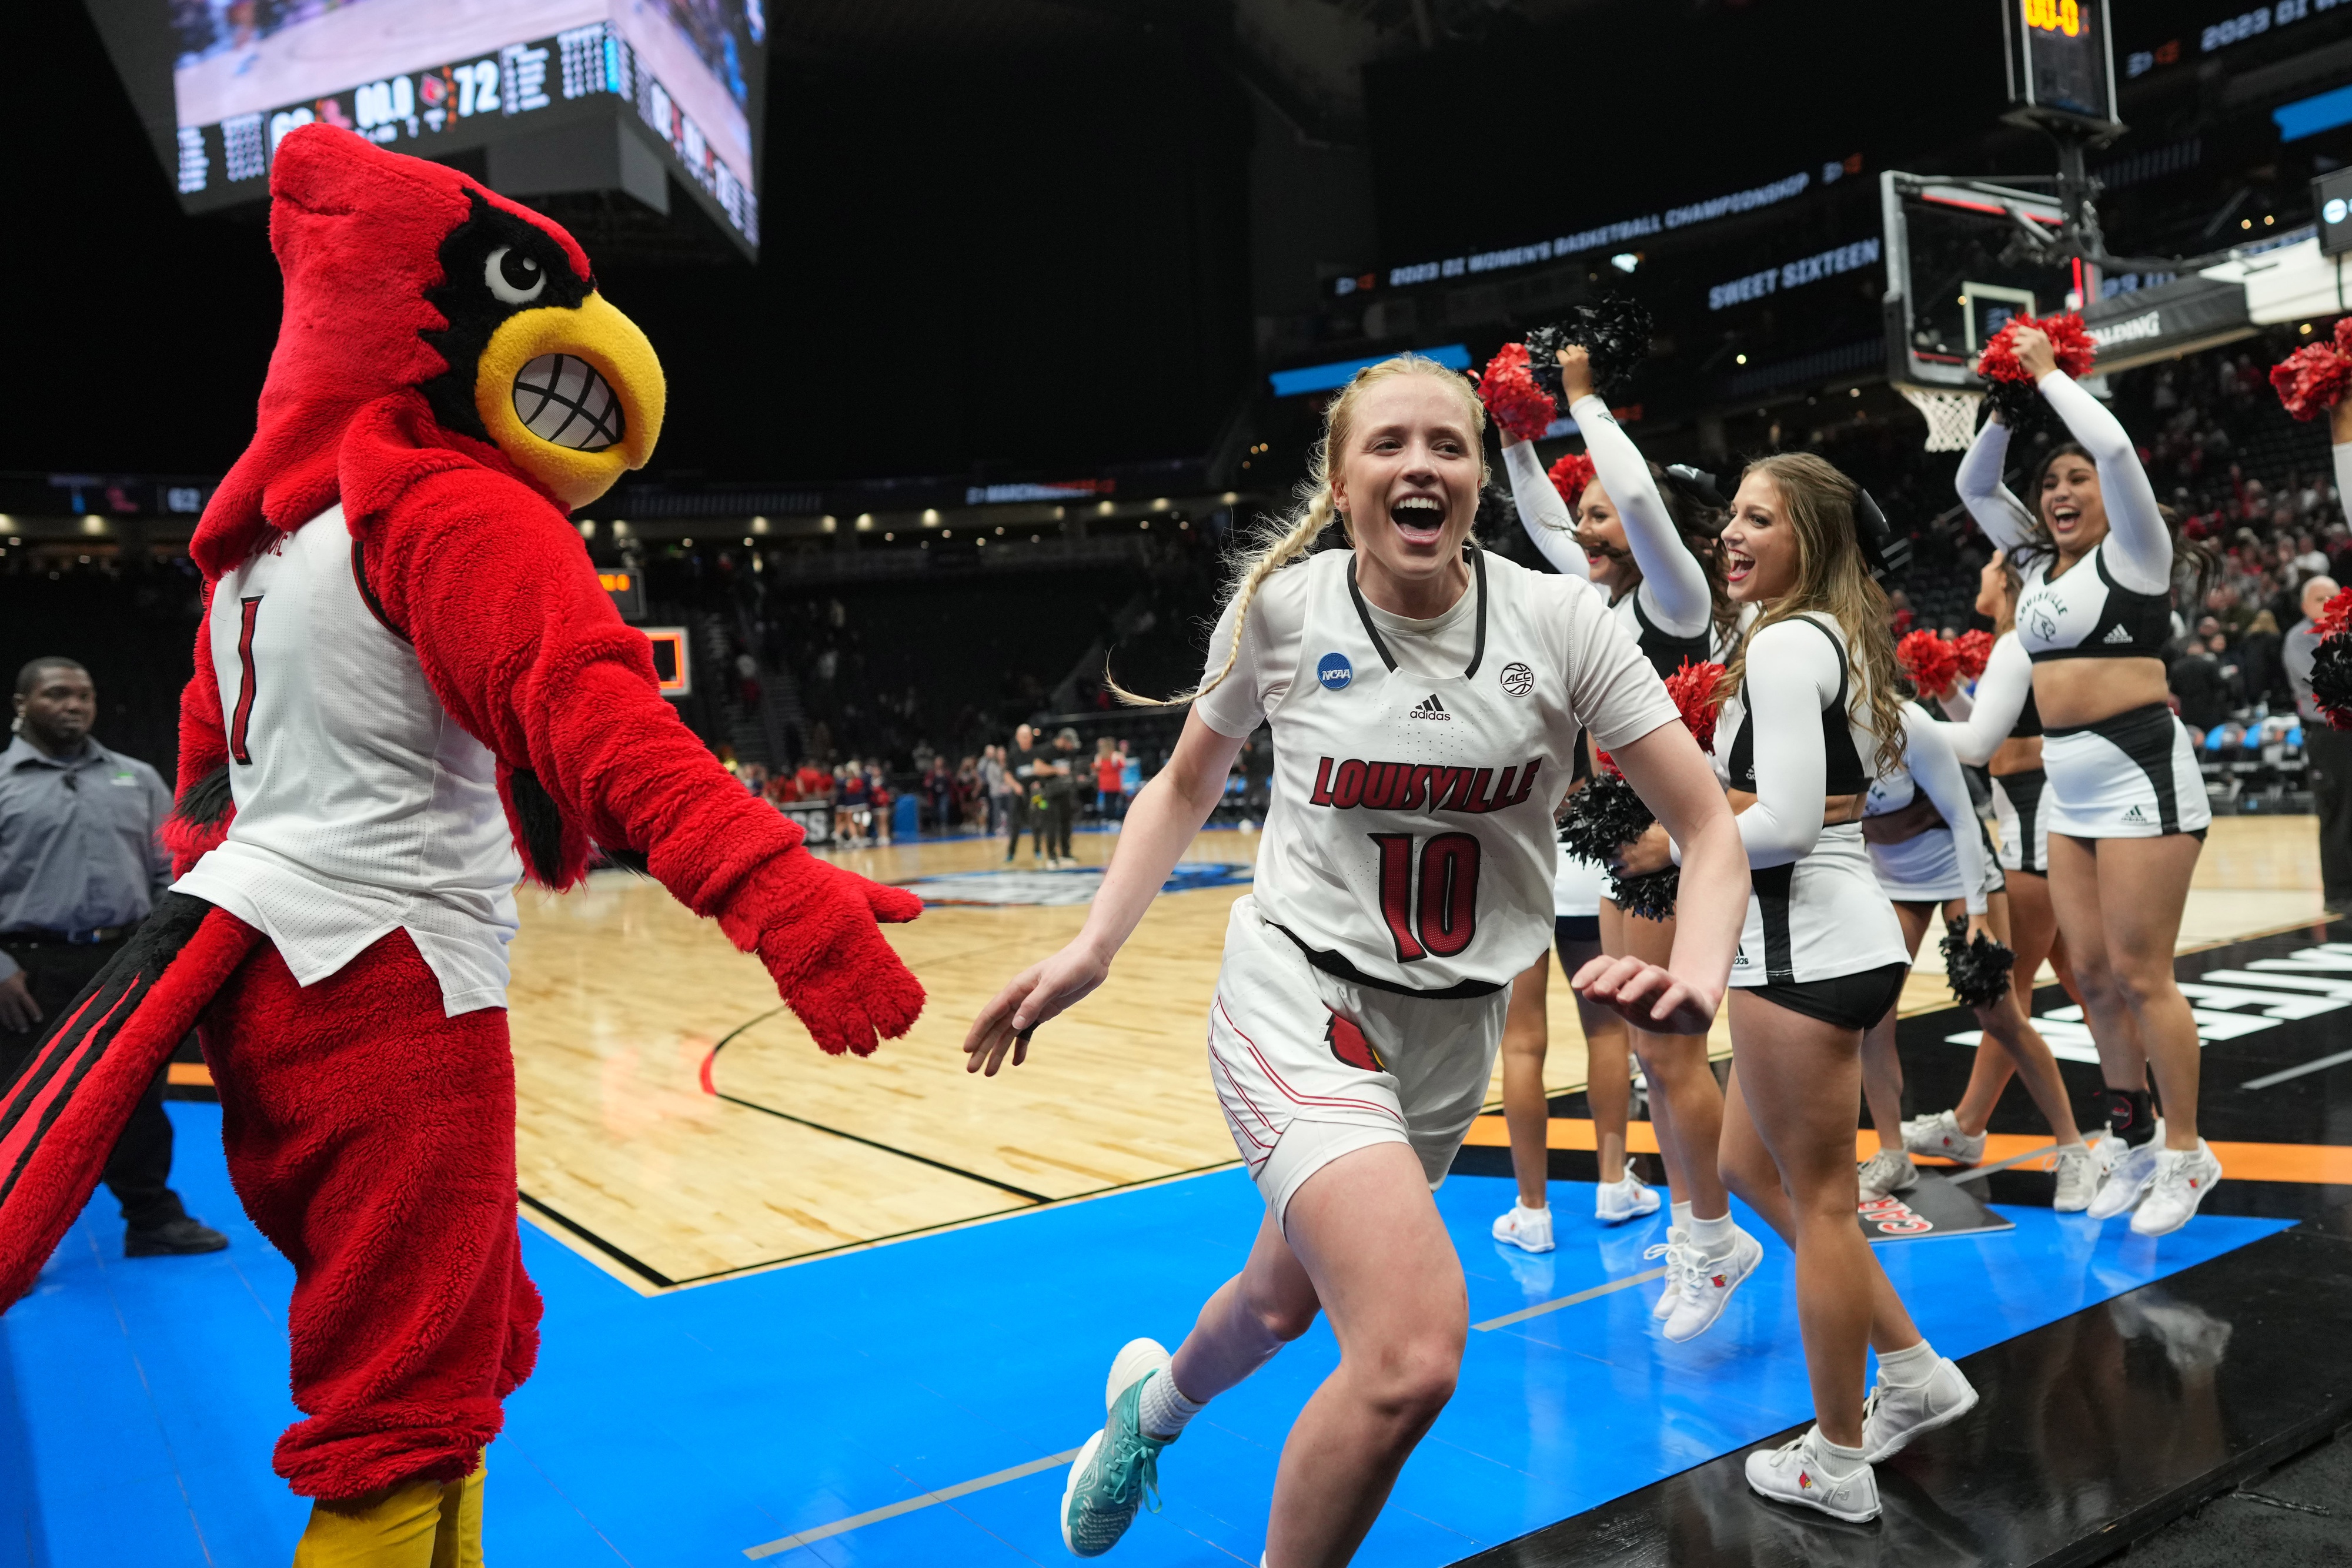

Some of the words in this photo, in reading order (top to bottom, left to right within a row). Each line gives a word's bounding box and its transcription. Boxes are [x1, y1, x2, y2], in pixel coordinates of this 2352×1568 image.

[2201, 6, 2271, 52] 2023
[452, 59, 501, 117] 72
[1553, 214, 1661, 257] BASKETBALL
[1664, 172, 1810, 229] CHAMPIONSHIP
[1709, 268, 1778, 310] SWEET
[1781, 237, 1880, 288] SIXTEEN
[2019, 590, 2068, 621] LOUISVILLE
[231, 594, 264, 765] 1
[1322, 669, 1351, 681] NCAA
[1506, 671, 1532, 682] ACC
[1409, 710, 1451, 721] adidas
[1309, 756, 1542, 814] LOUISVILLE
[1367, 831, 1481, 963] 10
